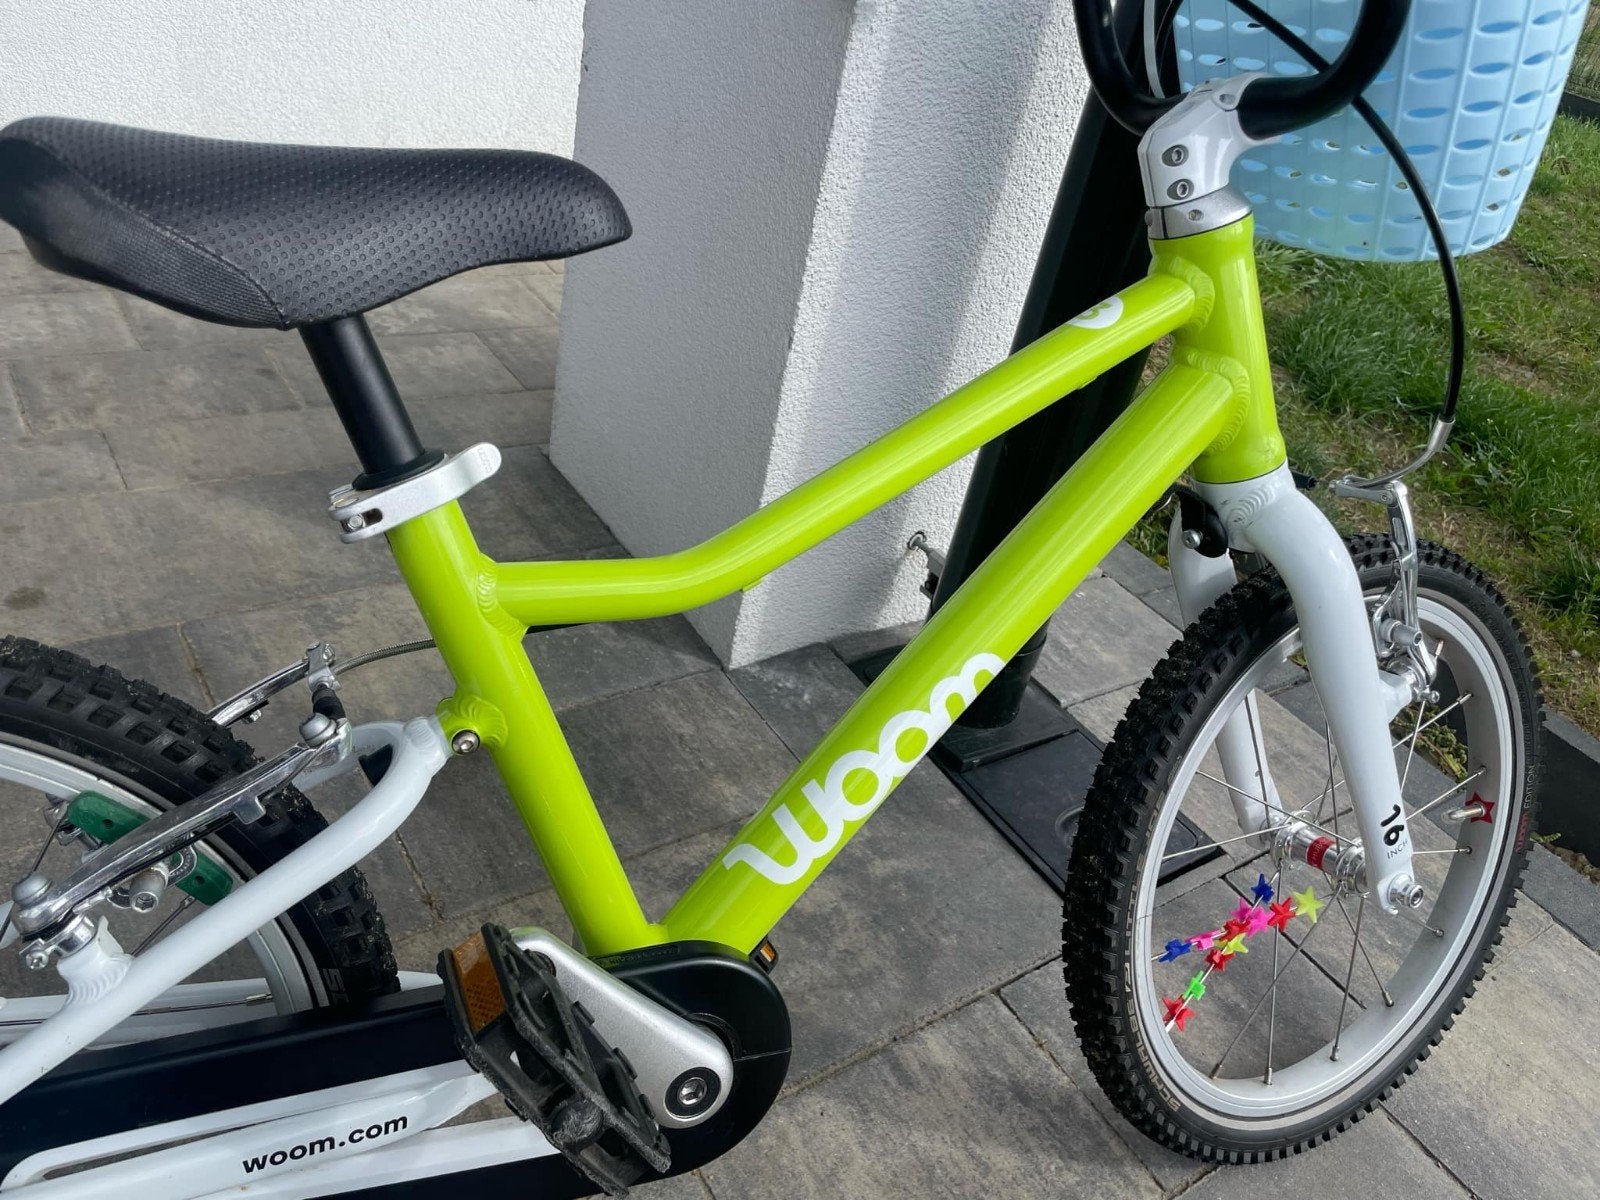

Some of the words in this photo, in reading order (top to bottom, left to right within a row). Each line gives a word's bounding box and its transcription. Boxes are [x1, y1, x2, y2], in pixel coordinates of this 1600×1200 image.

[722, 653, 1006, 885] woom
[1523, 764, 1535, 809] EDITION
[1380, 804, 1404, 846] 16
[1126, 999, 1181, 1112] SCHWALBE
[242, 1115, 408, 1173] woom.com
